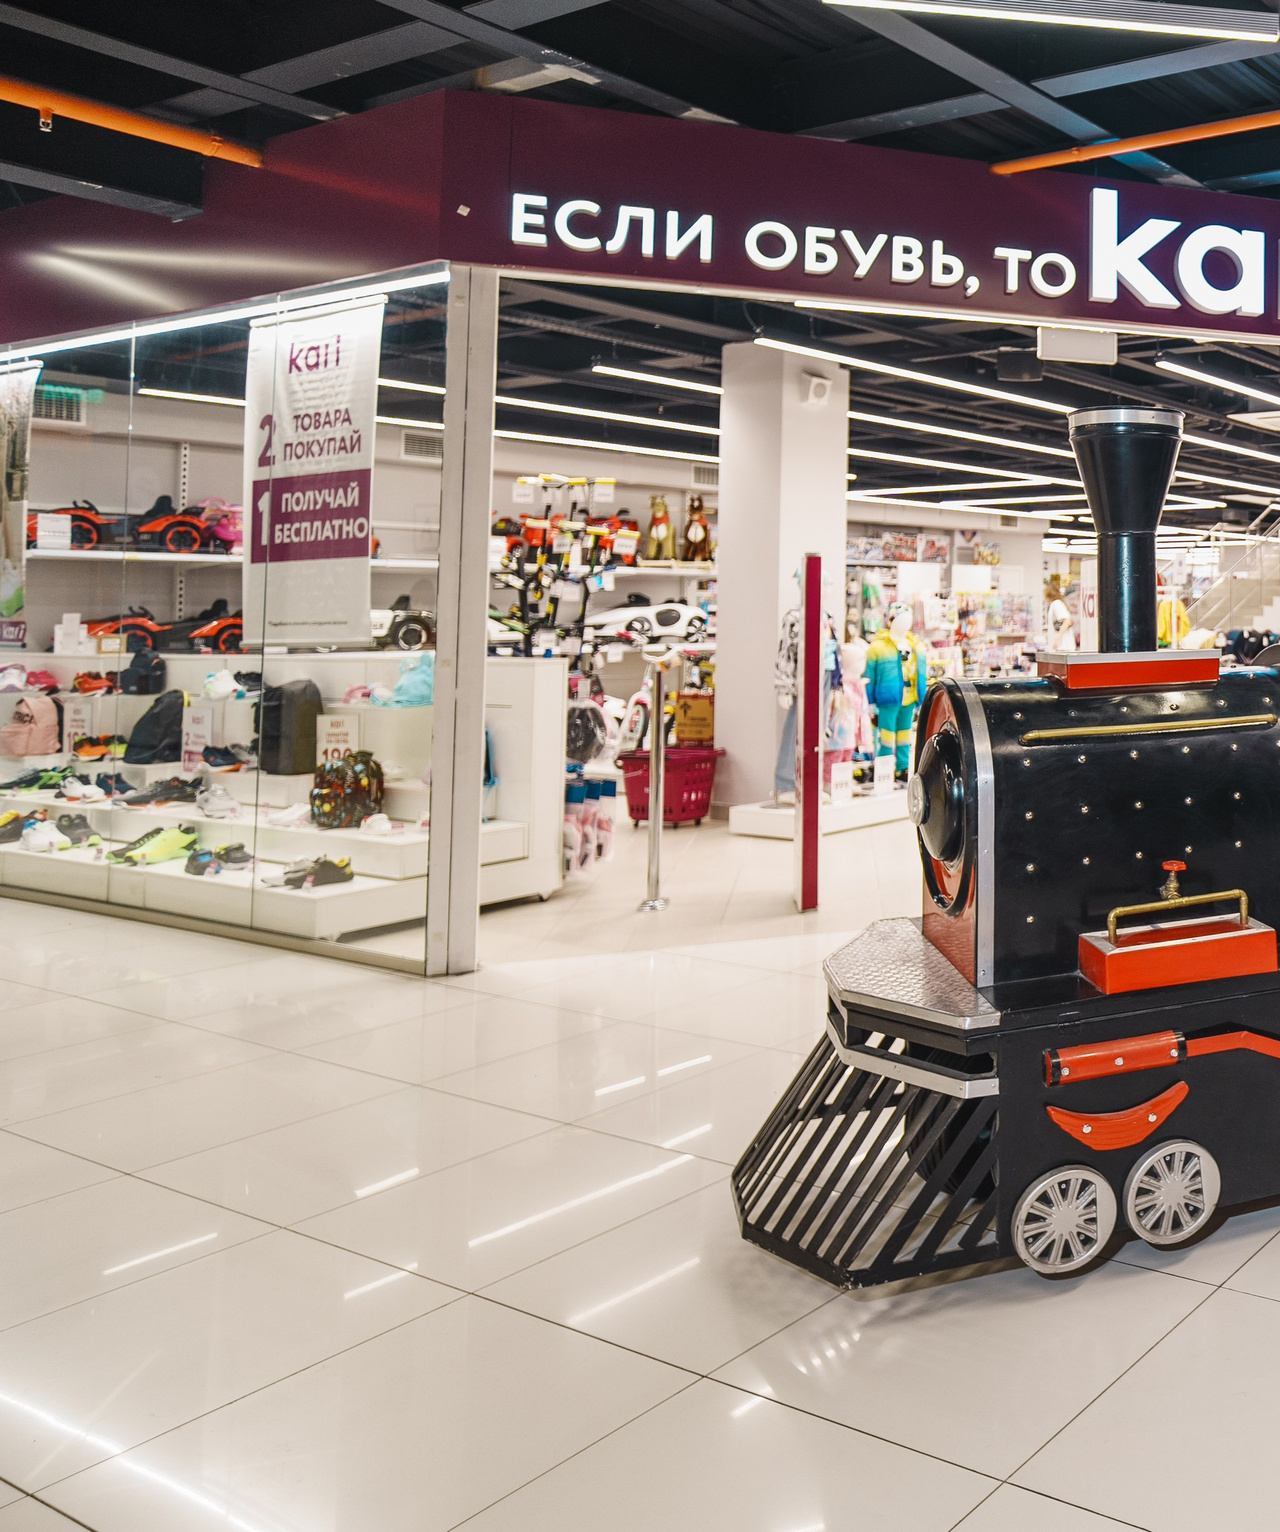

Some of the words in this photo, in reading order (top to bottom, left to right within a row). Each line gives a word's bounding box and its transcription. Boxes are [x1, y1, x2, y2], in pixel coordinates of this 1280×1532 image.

[511, 192, 713, 264] ЕСЛИ
[744, 220, 980, 298] ОБУВЬ,
[993, 246, 1077, 298] ТО
[288, 334, 341, 374] kari
[293, 408, 353, 433] ТОВАРА
[258, 414, 276, 468] 2
[283, 429, 362, 462] ПОКУПАЙ
[281, 481, 360, 514] ПОЛУЧАЙ
[257, 490, 271, 547] 1
[274, 516, 369, 545] БЕСПЛАТНО
[1082, 587, 1095, 618] ka
